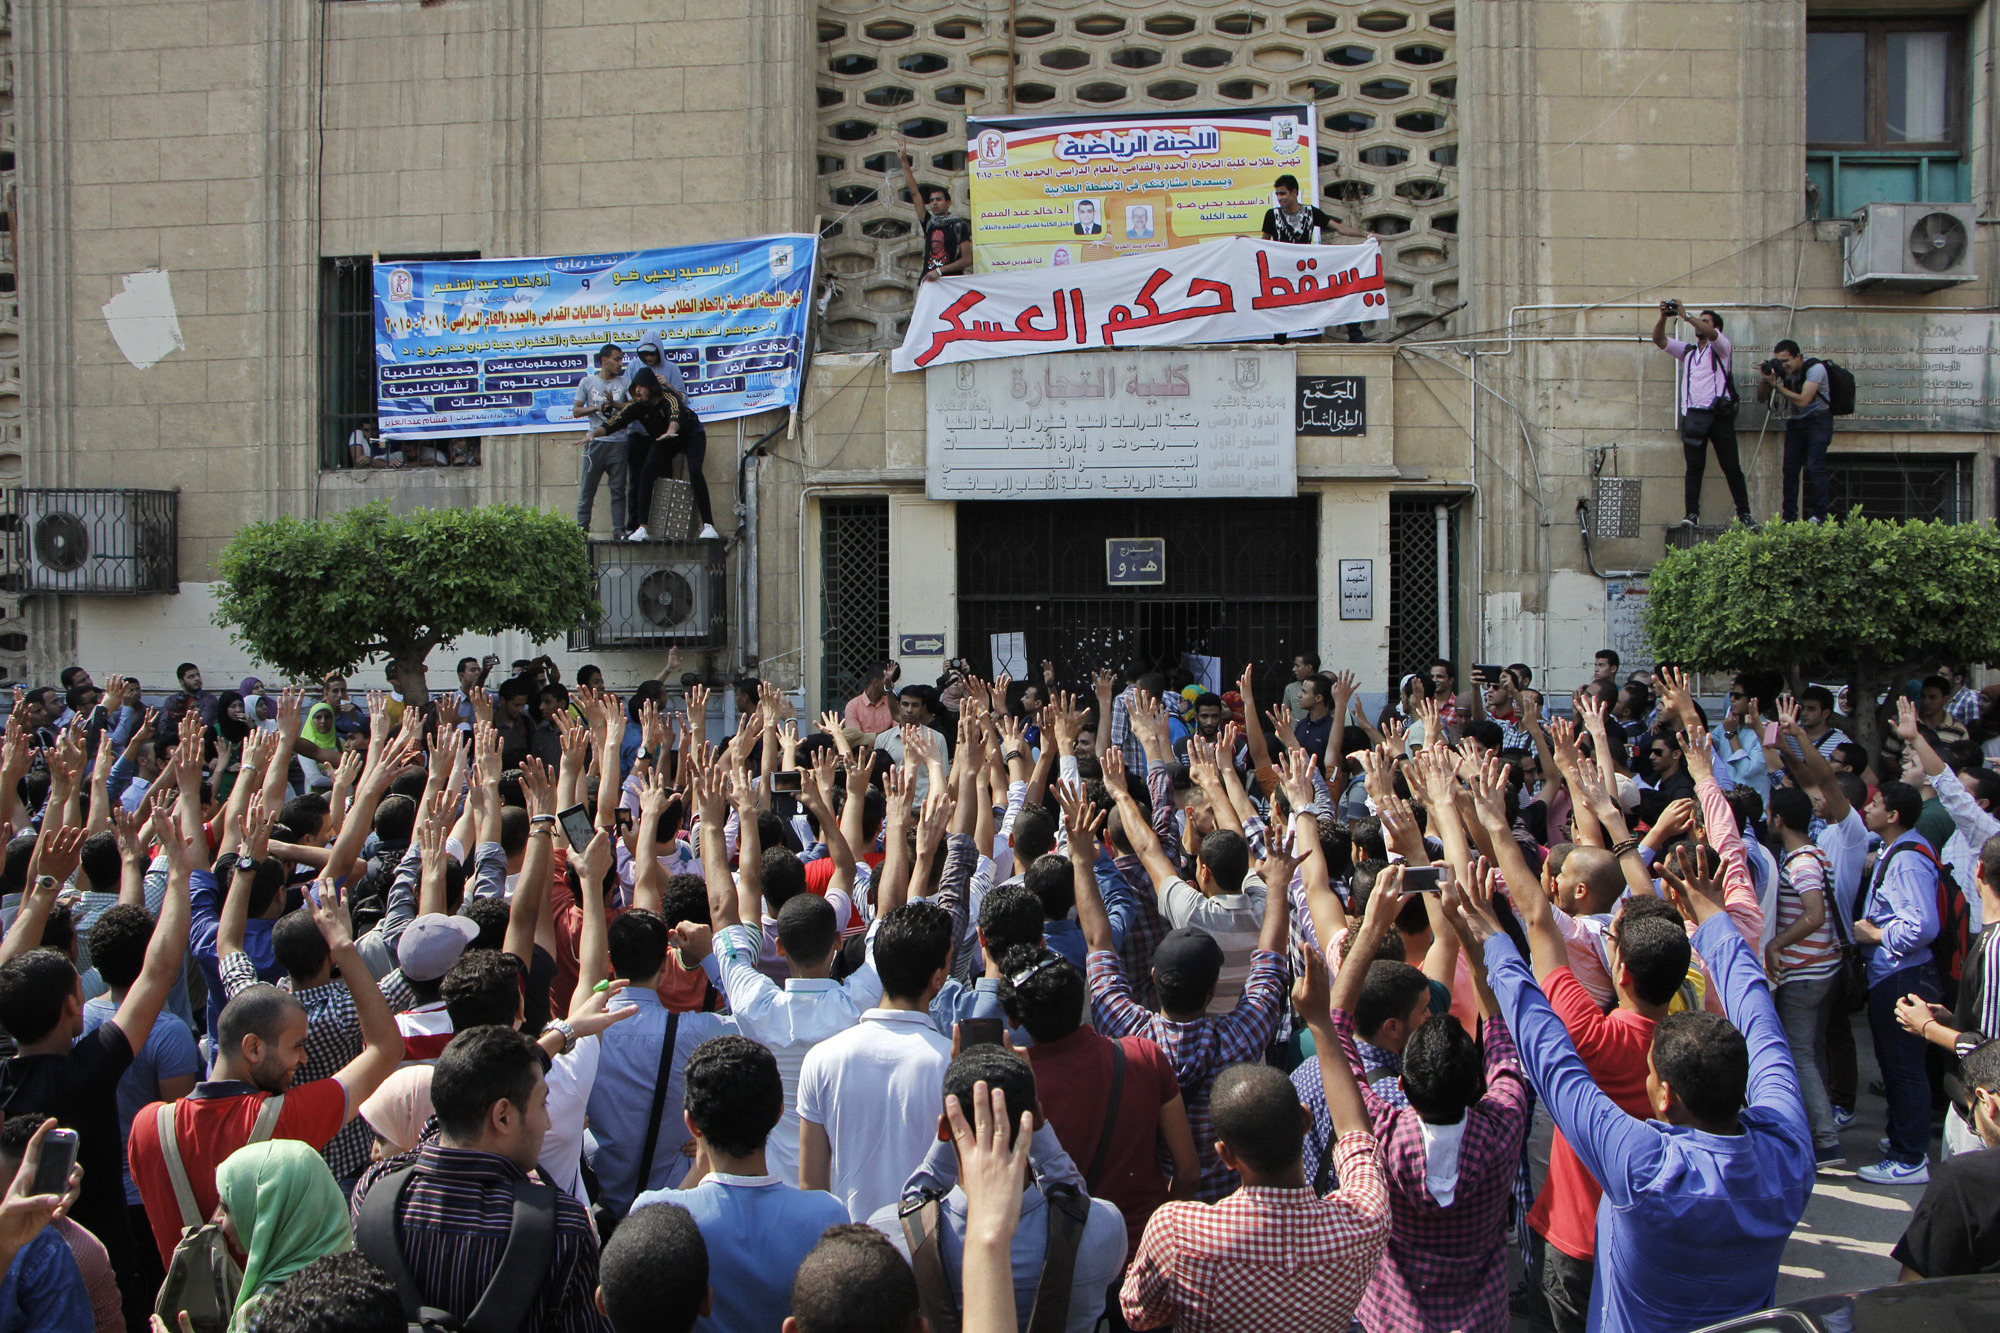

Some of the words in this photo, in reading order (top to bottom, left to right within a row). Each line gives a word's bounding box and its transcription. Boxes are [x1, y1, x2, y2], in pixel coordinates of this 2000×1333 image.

[1062, 135, 1148, 160] الرياضية
[1153, 131, 1217, 154] اللجنة
[1092, 165, 1119, 177] بالعام
[1122, 163, 1161, 176] والقدامى
[1164, 161, 1189, 171] الجدد
[1191, 159, 1224, 172] التجارة
[1226, 158, 1246, 170] كلية
[1250, 157, 1275, 170] طلاب
[1022, 167, 1053, 181] الجديد
[1055, 166, 1091, 180] الدراسى
[1044, 183, 1083, 197] الطلابية
[1085, 180, 1123, 194] الأنشطة
[1126, 181, 1139, 192] فى
[1141, 178, 1189, 192] مشاركتكم
[1191, 177, 1233, 188] ويسعدها
[1176, 200, 1197, 211] ضو
[1198, 200, 1223, 211] يحيى
[980, 208, 1010, 221] المنعم
[1012, 208, 1031, 219] عبد
[1200, 212, 1225, 223] الكلية
[1226, 212, 1248, 221] عميد
[554, 258, 588, 271] رعاية
[591, 254, 619, 268] تحت
[612, 268, 641, 286] ضو
[643, 267, 678, 284] يحيى
[1252, 250, 1386, 310] يسقط
[430, 279, 475, 297] المنعم
[476, 278, 500, 293] عبد
[581, 278, 591, 291] و
[699, 297, 726, 317] باتحاد
[726, 293, 758, 314] العلمية
[759, 290, 786, 313] اللجنة
[1101, 268, 1237, 346] حكم
[573, 304, 611, 326] والطالبات
[613, 303, 639, 323] الطلبة
[640, 302, 666, 321] جميع
[668, 298, 697, 321] الطلاب
[449, 312, 484, 334] الدراسى
[484, 310, 508, 334] بالعام
[509, 309, 537, 329] والجدد
[537, 307, 571, 328] القدامى
[667, 325, 721, 341] للمشاركة
[914, 287, 1087, 368] العسكر
[570, 331, 612, 346] العلمية
[613, 329, 648, 345] لجنة
[466, 341, 490, 354] فوق
[717, 341, 758, 357] علمية
[558, 358, 583, 370] دورى
[665, 350, 694, 363] دورات
[422, 365, 475, 380] جمعيات
[487, 361, 514, 374] علمى
[514, 359, 559, 371] معلومات
[724, 360, 784, 375] معارض
[383, 370, 422, 381] علمية
[540, 375, 572, 388] نادى
[388, 385, 430, 397] علمية
[431, 381, 470, 394] نشرات
[499, 377, 541, 391] علوم
[700, 377, 737, 394] أبحاث
[1010, 365, 1116, 408] التجارة
[1125, 363, 1190, 405] كلية
[450, 395, 514, 409] اختراعات
[421, 415, 448, 426] هشام
[944, 415, 977, 433] العليا
[979, 414, 1031, 433] الدراسات
[1076, 413, 1107, 431] العليا
[1110, 412, 1161, 431] الدراسات
[1165, 412, 1200, 431] مكتبة
[1250, 412, 1279, 429] الدور
[1296, 408, 1337, 432] الشامل
[941, 455, 1075, 474] الطبى
[1078, 454, 1199, 473] المجمع
[942, 475, 1013, 494] الرياضية
[1060, 475, 1093, 493] صالة
[1101, 474, 1156, 493] الرياضية
[1157, 473, 1198, 492] اللجنة
[1120, 546, 1154, 557] مدرج
[1113, 562, 1127, 578] و
[1347, 563, 1365, 572] مبنى
[1345, 574, 1368, 584] الشهيد
